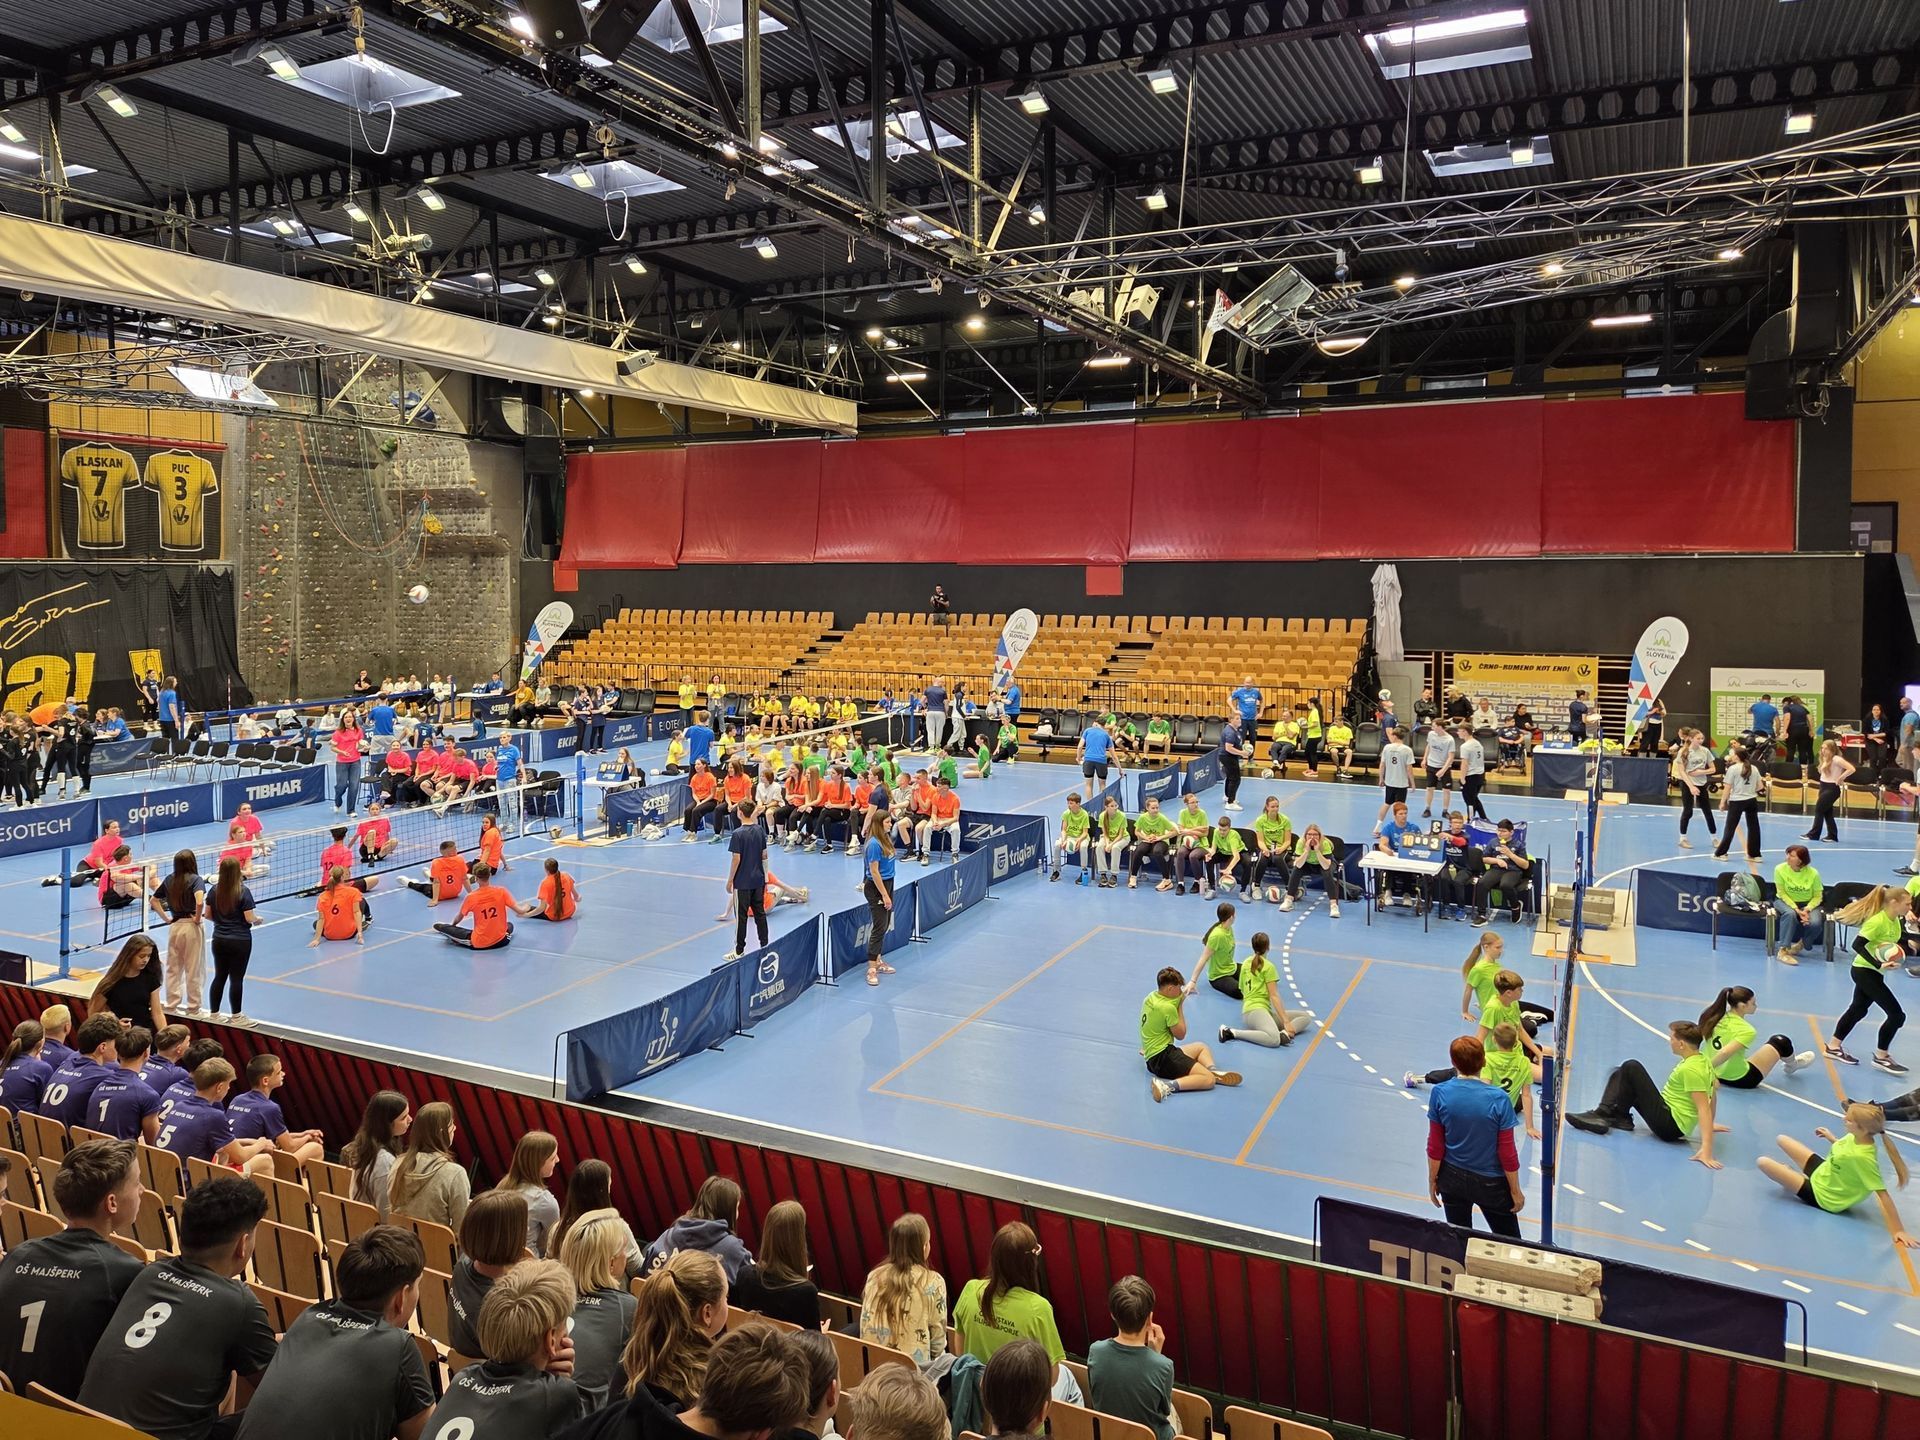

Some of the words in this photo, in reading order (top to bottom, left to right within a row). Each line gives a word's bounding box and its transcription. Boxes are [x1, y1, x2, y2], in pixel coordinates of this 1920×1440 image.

[172, 463, 190, 474] PUC
[91, 470, 108, 496] 7
[174, 476, 187, 501] 3
[1646, 651, 1675, 660] SLOVENIA
[365, 731, 374, 739] 10
[557, 735, 578, 749] EKIP
[1391, 756, 1398, 765] 8
[246, 779, 302, 800] TIBHAR
[128, 800, 190, 824] gorenje
[1402, 834, 1415, 847] 10
[1430, 838, 1439, 849] 3
[1009, 843, 1037, 867] triglav
[446, 874, 454, 885] 8
[331, 903, 340, 915] 6
[481, 906, 498, 920] 12
[1141, 1013, 1147, 1027] 9
[1712, 1035, 1723, 1051] 6
[1501, 1077, 1513, 1093] 2
[43, 1082, 69, 1106] 10
[99, 1098, 110, 1123] 1
[158, 1099, 175, 1121] 2
[156, 1125, 178, 1149] 5
[15, 1263, 32, 1275] OŠ
[30, 1265, 83, 1280] MAJŠPERK
[157, 1271, 172, 1281] OŠ
[170, 1276, 214, 1298] MAJŠPERK
[575, 1296, 602, 1306] ŠPERK
[315, 1312, 332, 1320] OŠ
[20, 1300, 47, 1353] 1
[124, 1301, 173, 1349] 8
[458, 1376, 473, 1388] OŠ
[471, 1383, 515, 1397] MAJŠPERK
